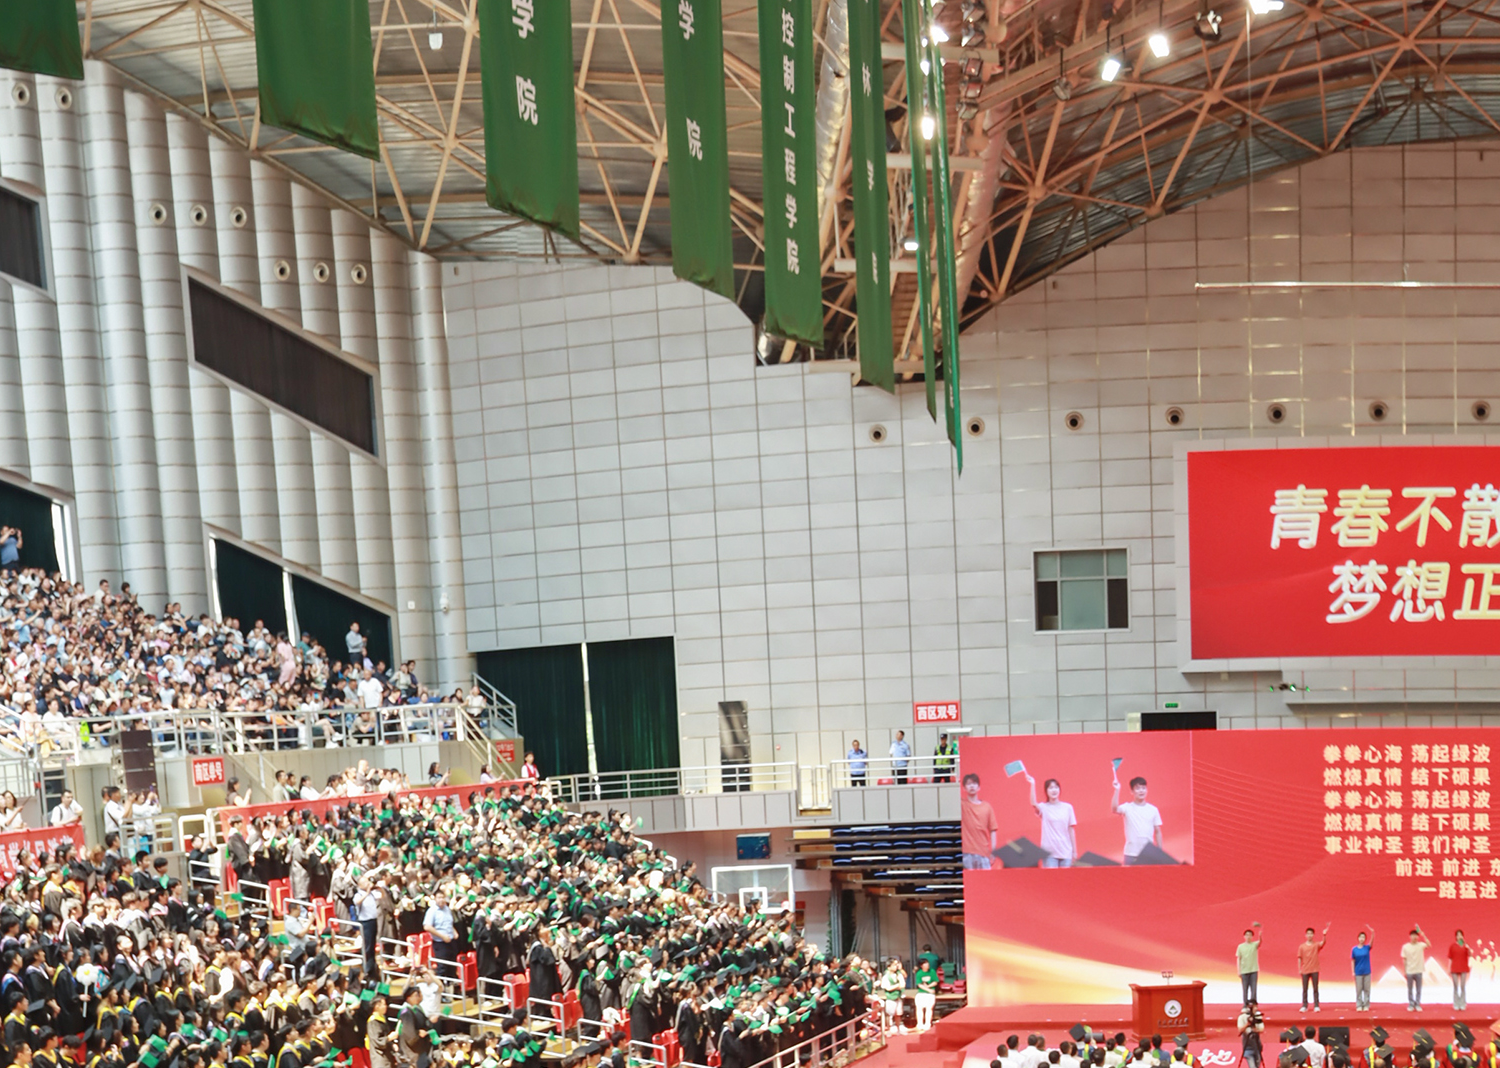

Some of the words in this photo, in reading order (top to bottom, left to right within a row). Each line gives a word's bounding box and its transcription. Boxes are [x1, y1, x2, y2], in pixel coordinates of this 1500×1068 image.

[780, 0, 800, 276] 控制工程学院
[916, 704, 959, 721] 西区双号
[1324, 744, 1403, 764] 拳拳心海
[1411, 744, 1491, 764] 荡起绿波
[1324, 767, 1403, 787] 燃烧真情
[1411, 767, 1491, 787] 结下硕果
[1324, 790, 1403, 810] 拳拳心海
[1411, 790, 1491, 810] 荡起绿波
[1324, 813, 1403, 832] 燃烧真情
[1411, 813, 1491, 832] 结下硕果
[1324, 835, 1403, 855] 事业神圣
[1411, 835, 1491, 855] 我们神圣
[1395, 858, 1434, 877] 前进
[1441, 858, 1481, 877] 前进
[1418, 880, 1497, 900] 一路猛进
